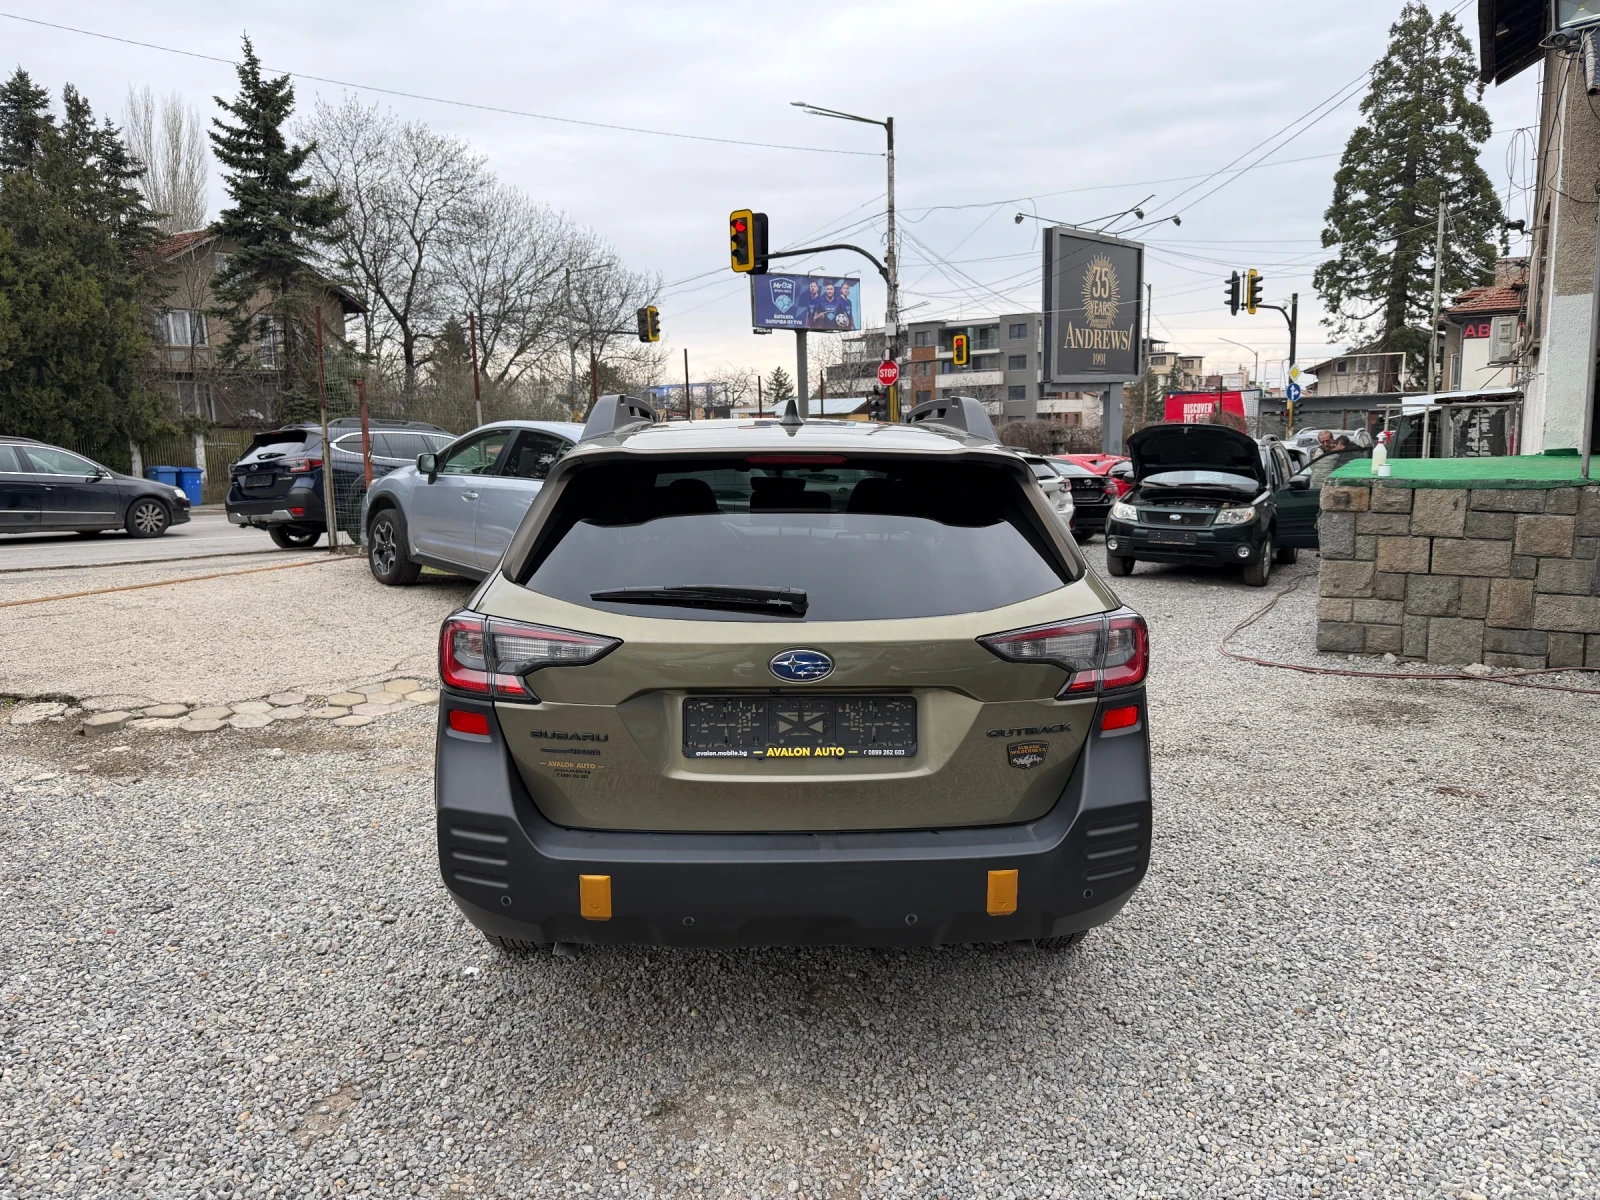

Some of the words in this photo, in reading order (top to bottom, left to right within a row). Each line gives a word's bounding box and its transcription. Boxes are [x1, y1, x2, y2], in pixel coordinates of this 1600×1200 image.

[1092, 266, 1110, 298] 35
[1090, 301, 1111, 316] YEARS
[1092, 353, 1106, 365] 1991
[880, 368, 897, 378] STOP
[1183, 403, 1213, 414] DISCOVER
[529, 729, 609, 742] SUBARU
[986, 722, 1072, 738] OUTBACK
[766, 747, 811, 757] AVALON
[814, 747, 845, 757] AUTO
[548, 760, 575, 768] AVALON
